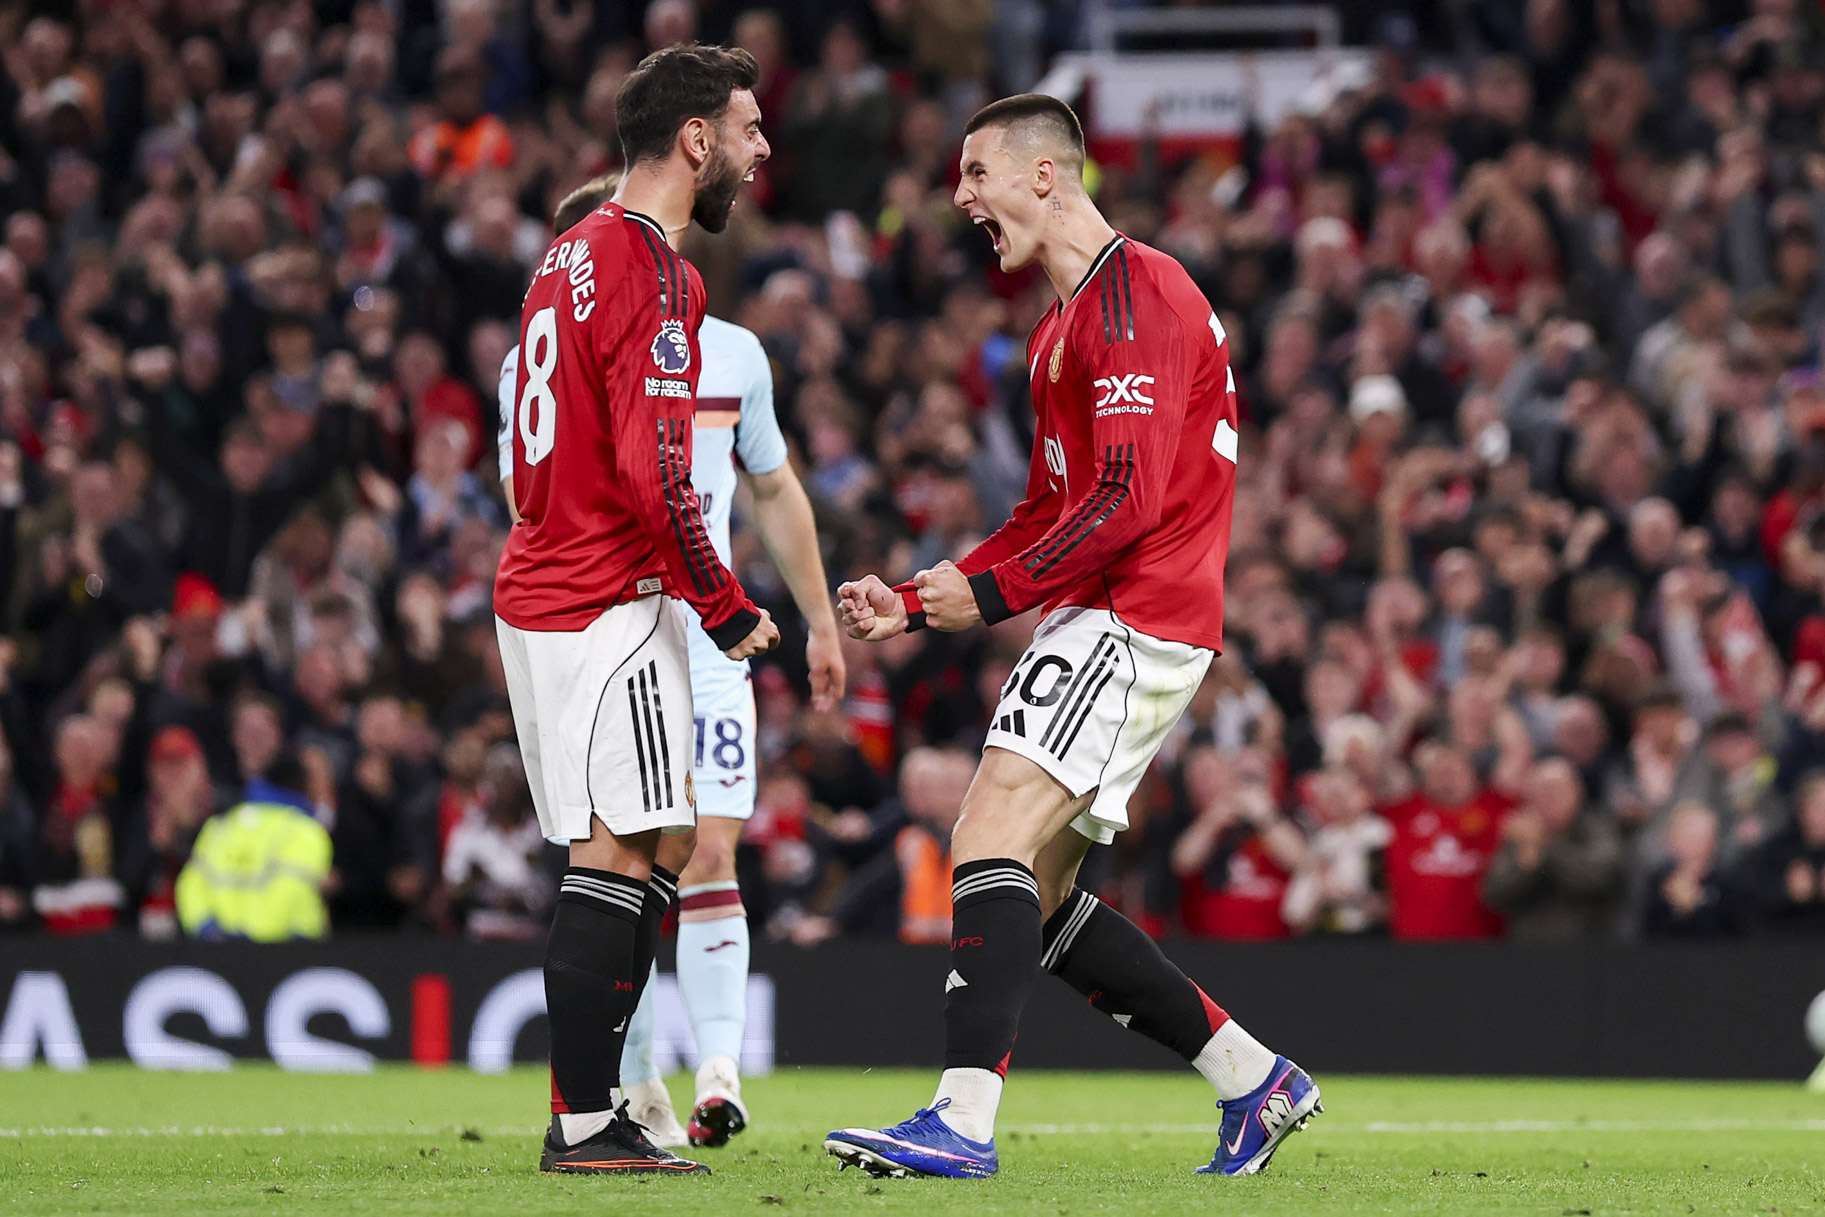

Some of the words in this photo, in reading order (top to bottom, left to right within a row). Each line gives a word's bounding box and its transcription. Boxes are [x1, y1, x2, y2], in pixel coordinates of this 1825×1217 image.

[519, 306, 558, 467] 8
[645, 377, 660, 388] No
[661, 379, 689, 391] room
[660, 388, 692, 399] racism
[1093, 373, 1155, 408] DXC
[1095, 404, 1154, 419] TECHNOLOGY
[693, 717, 745, 770] 18
[0, 965, 776, 1073] ASSI
